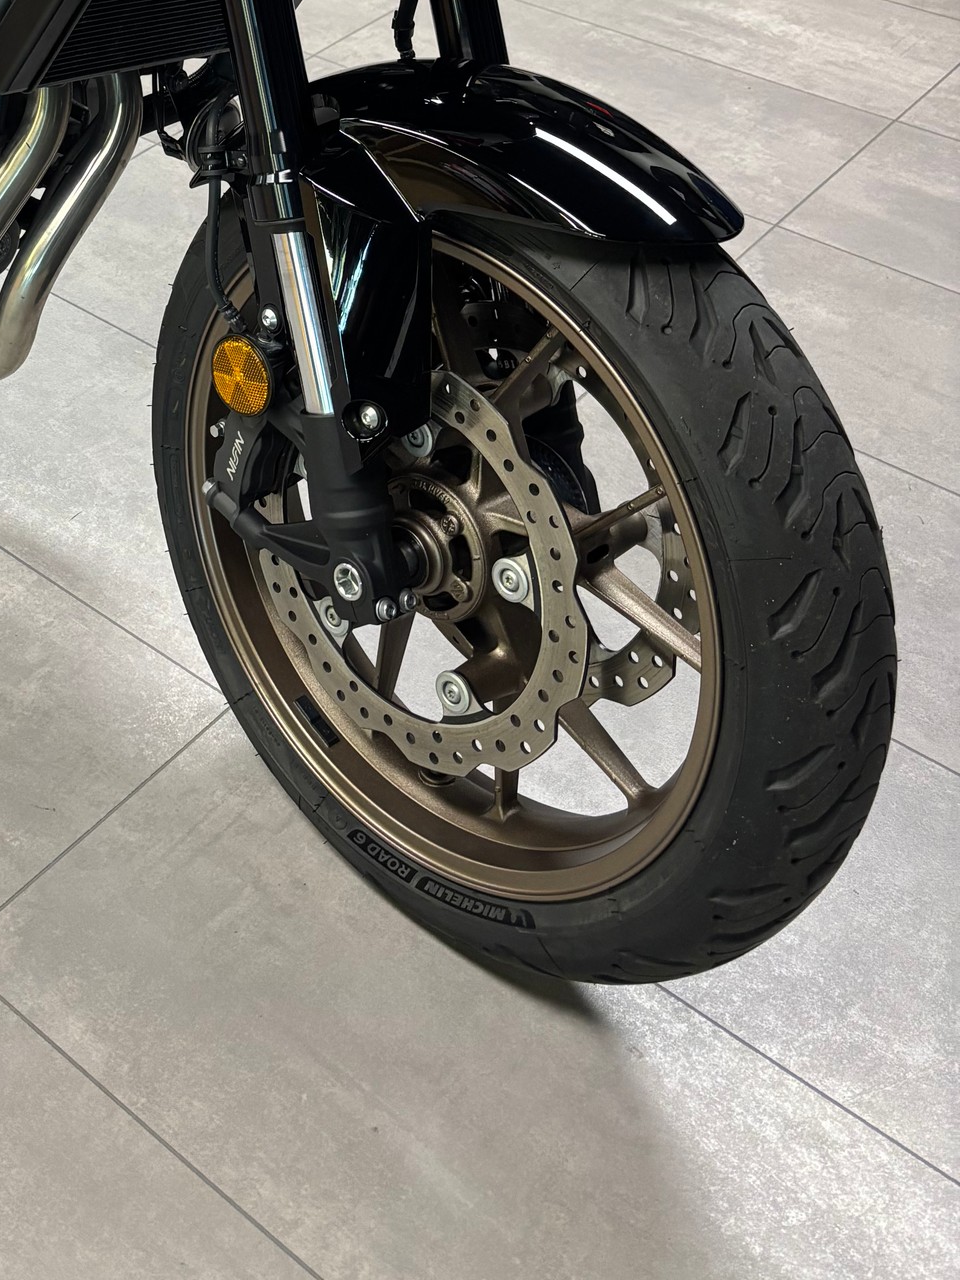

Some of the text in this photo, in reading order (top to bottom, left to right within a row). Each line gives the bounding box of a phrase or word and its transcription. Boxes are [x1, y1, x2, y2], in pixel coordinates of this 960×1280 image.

[227, 430, 244, 481] NISSIN
[353, 831, 410, 880] ROAD 6
[424, 880, 506, 921] MICHELIN
